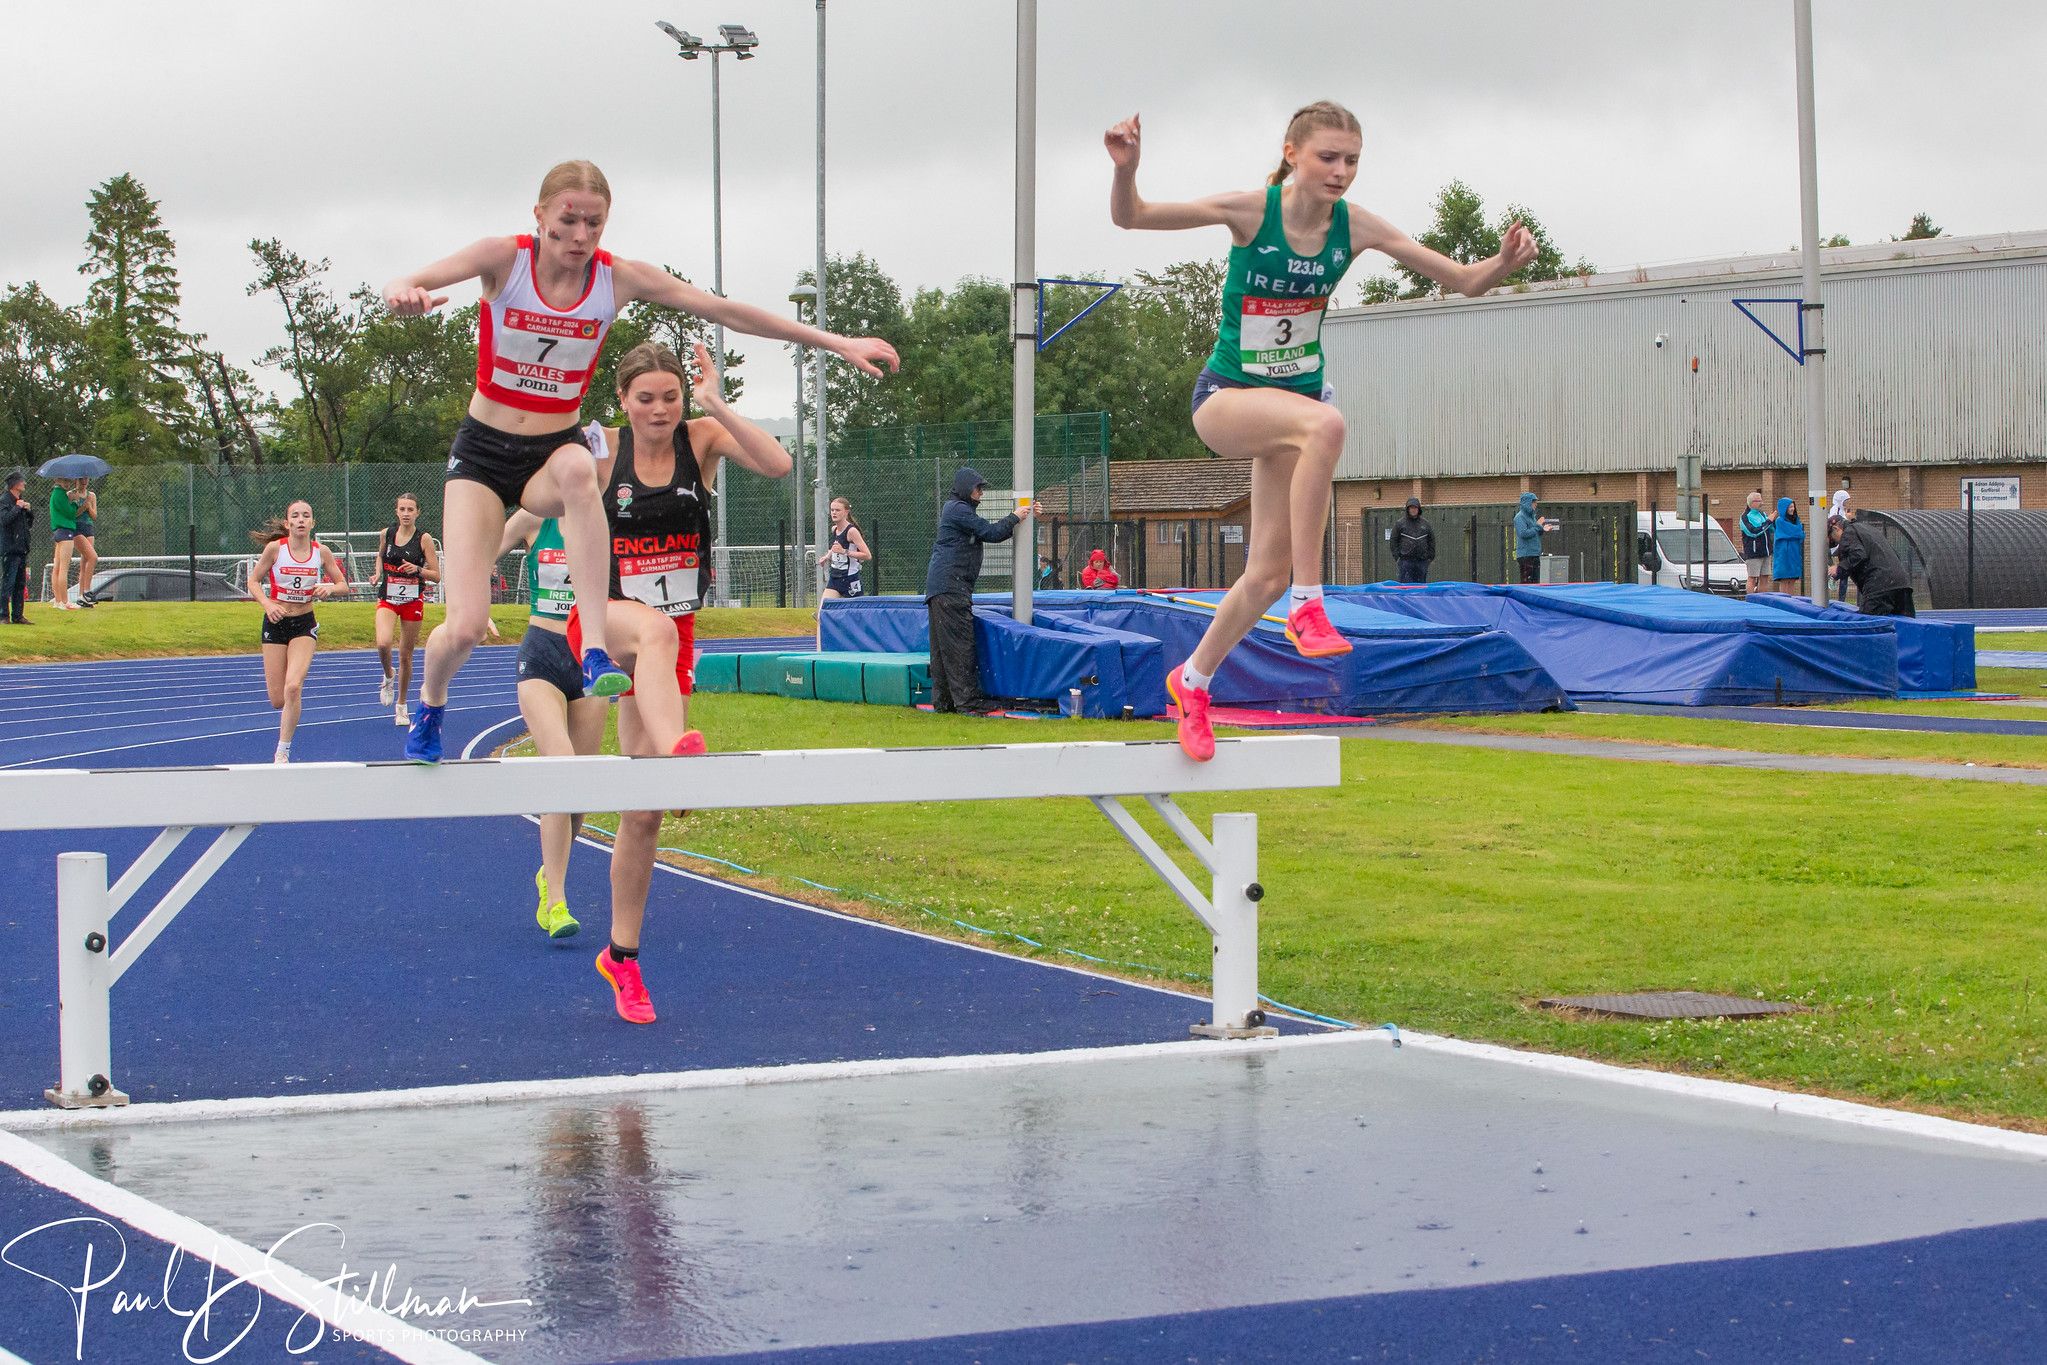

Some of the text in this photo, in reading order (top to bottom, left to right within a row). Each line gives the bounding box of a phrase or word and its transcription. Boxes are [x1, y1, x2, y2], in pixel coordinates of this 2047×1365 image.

[1287, 258, 1325, 276] 123.ie
[1246, 270, 1333, 295] IRELAN
[527, 323, 575, 336] CARMARTHEN
[1274, 318, 1293, 346] 3
[537, 337, 558, 363] 7
[1256, 346, 1305, 363] IRELAND
[516, 363, 566, 382] WALES
[613, 533, 701, 555] ENGLAND
[640, 562, 679, 573] CARMARTHEN
[293, 576, 302, 589] 8
[398, 585, 407, 596] 2
[655, 574, 669, 601] 1
[549, 590, 574, 601] IREL
[655, 602, 692, 614] LAND
